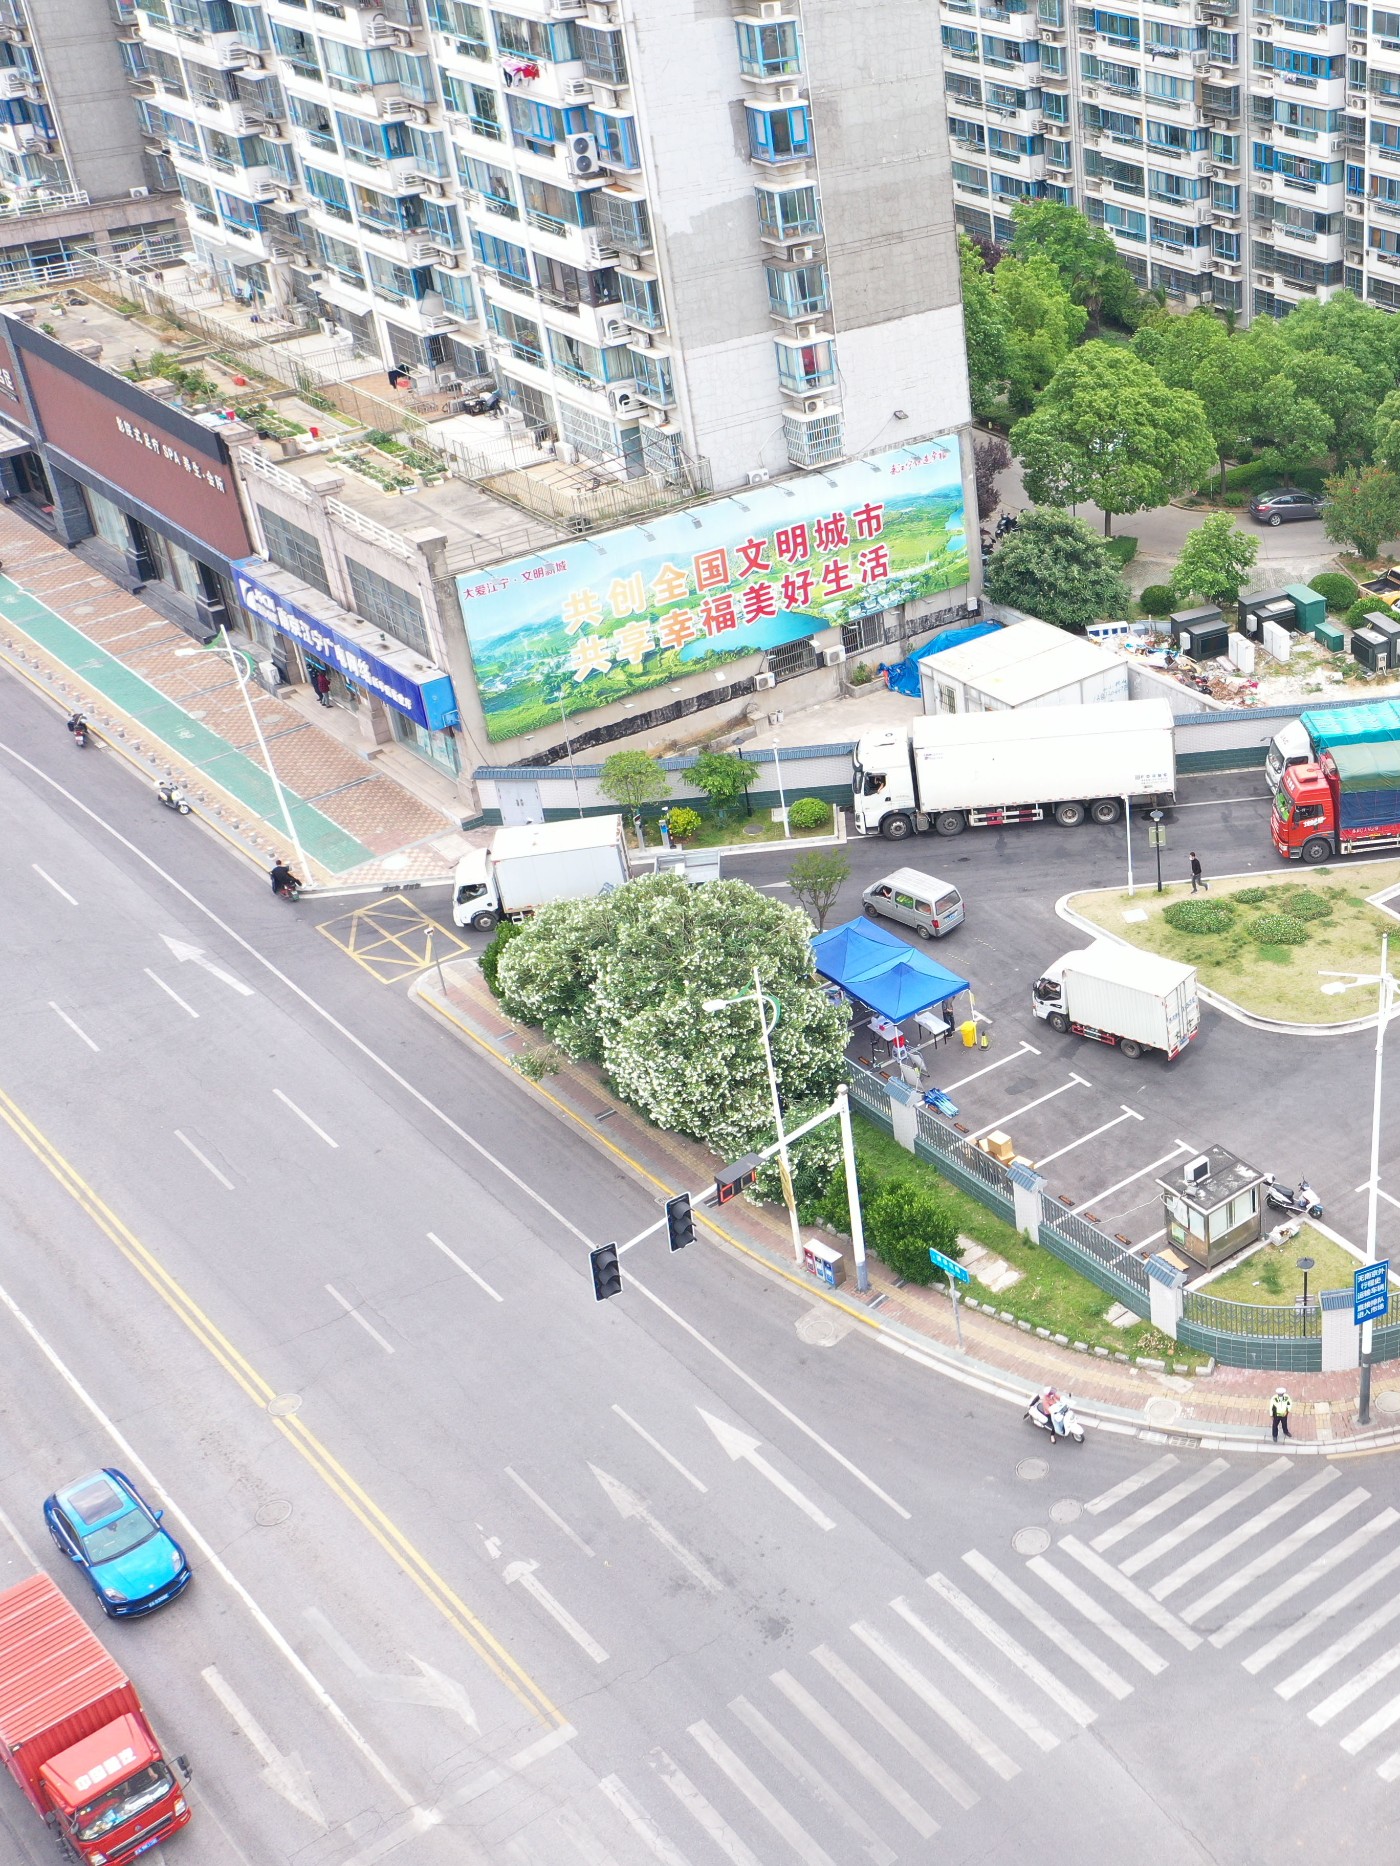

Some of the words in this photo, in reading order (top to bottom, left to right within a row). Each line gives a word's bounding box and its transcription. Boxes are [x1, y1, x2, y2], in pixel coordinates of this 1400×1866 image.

[162, 444, 182, 466] SPA
[182, 455, 225, 494] 养生·会所
[562, 502, 885, 635] 共创全国文明城市
[571, 544, 890, 684] 共享幸福美好生活
[1357, 1268, 1385, 1283] 无南京外
[1357, 1284, 1385, 1300] 运输车辆
[1356, 1304, 1385, 1320] 进入市场
